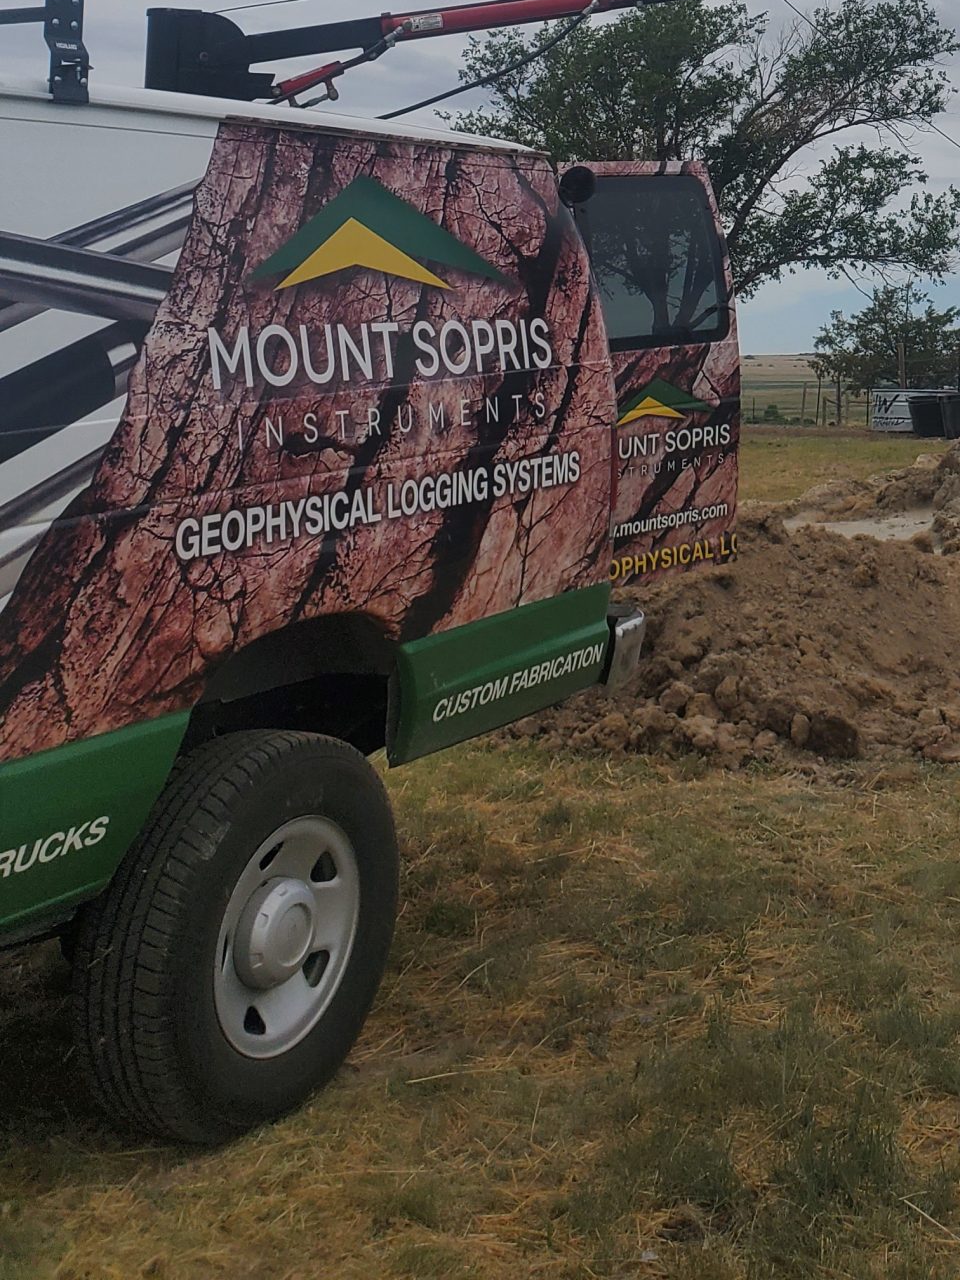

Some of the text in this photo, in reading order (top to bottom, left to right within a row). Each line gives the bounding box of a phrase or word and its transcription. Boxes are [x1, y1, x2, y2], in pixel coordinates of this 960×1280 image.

[207, 317, 553, 390] MOUNT SOPRIS
[237, 394, 547, 451] INSTRUMENTS
[618, 424, 731, 459] UNT SOPRIS
[174, 451, 581, 561] GEOPHYSICAL LOGGING SYSTEMS
[432, 642, 605, 723] CUSTOM FABRICATION
[0, 815, 110, 878] RUCKS
